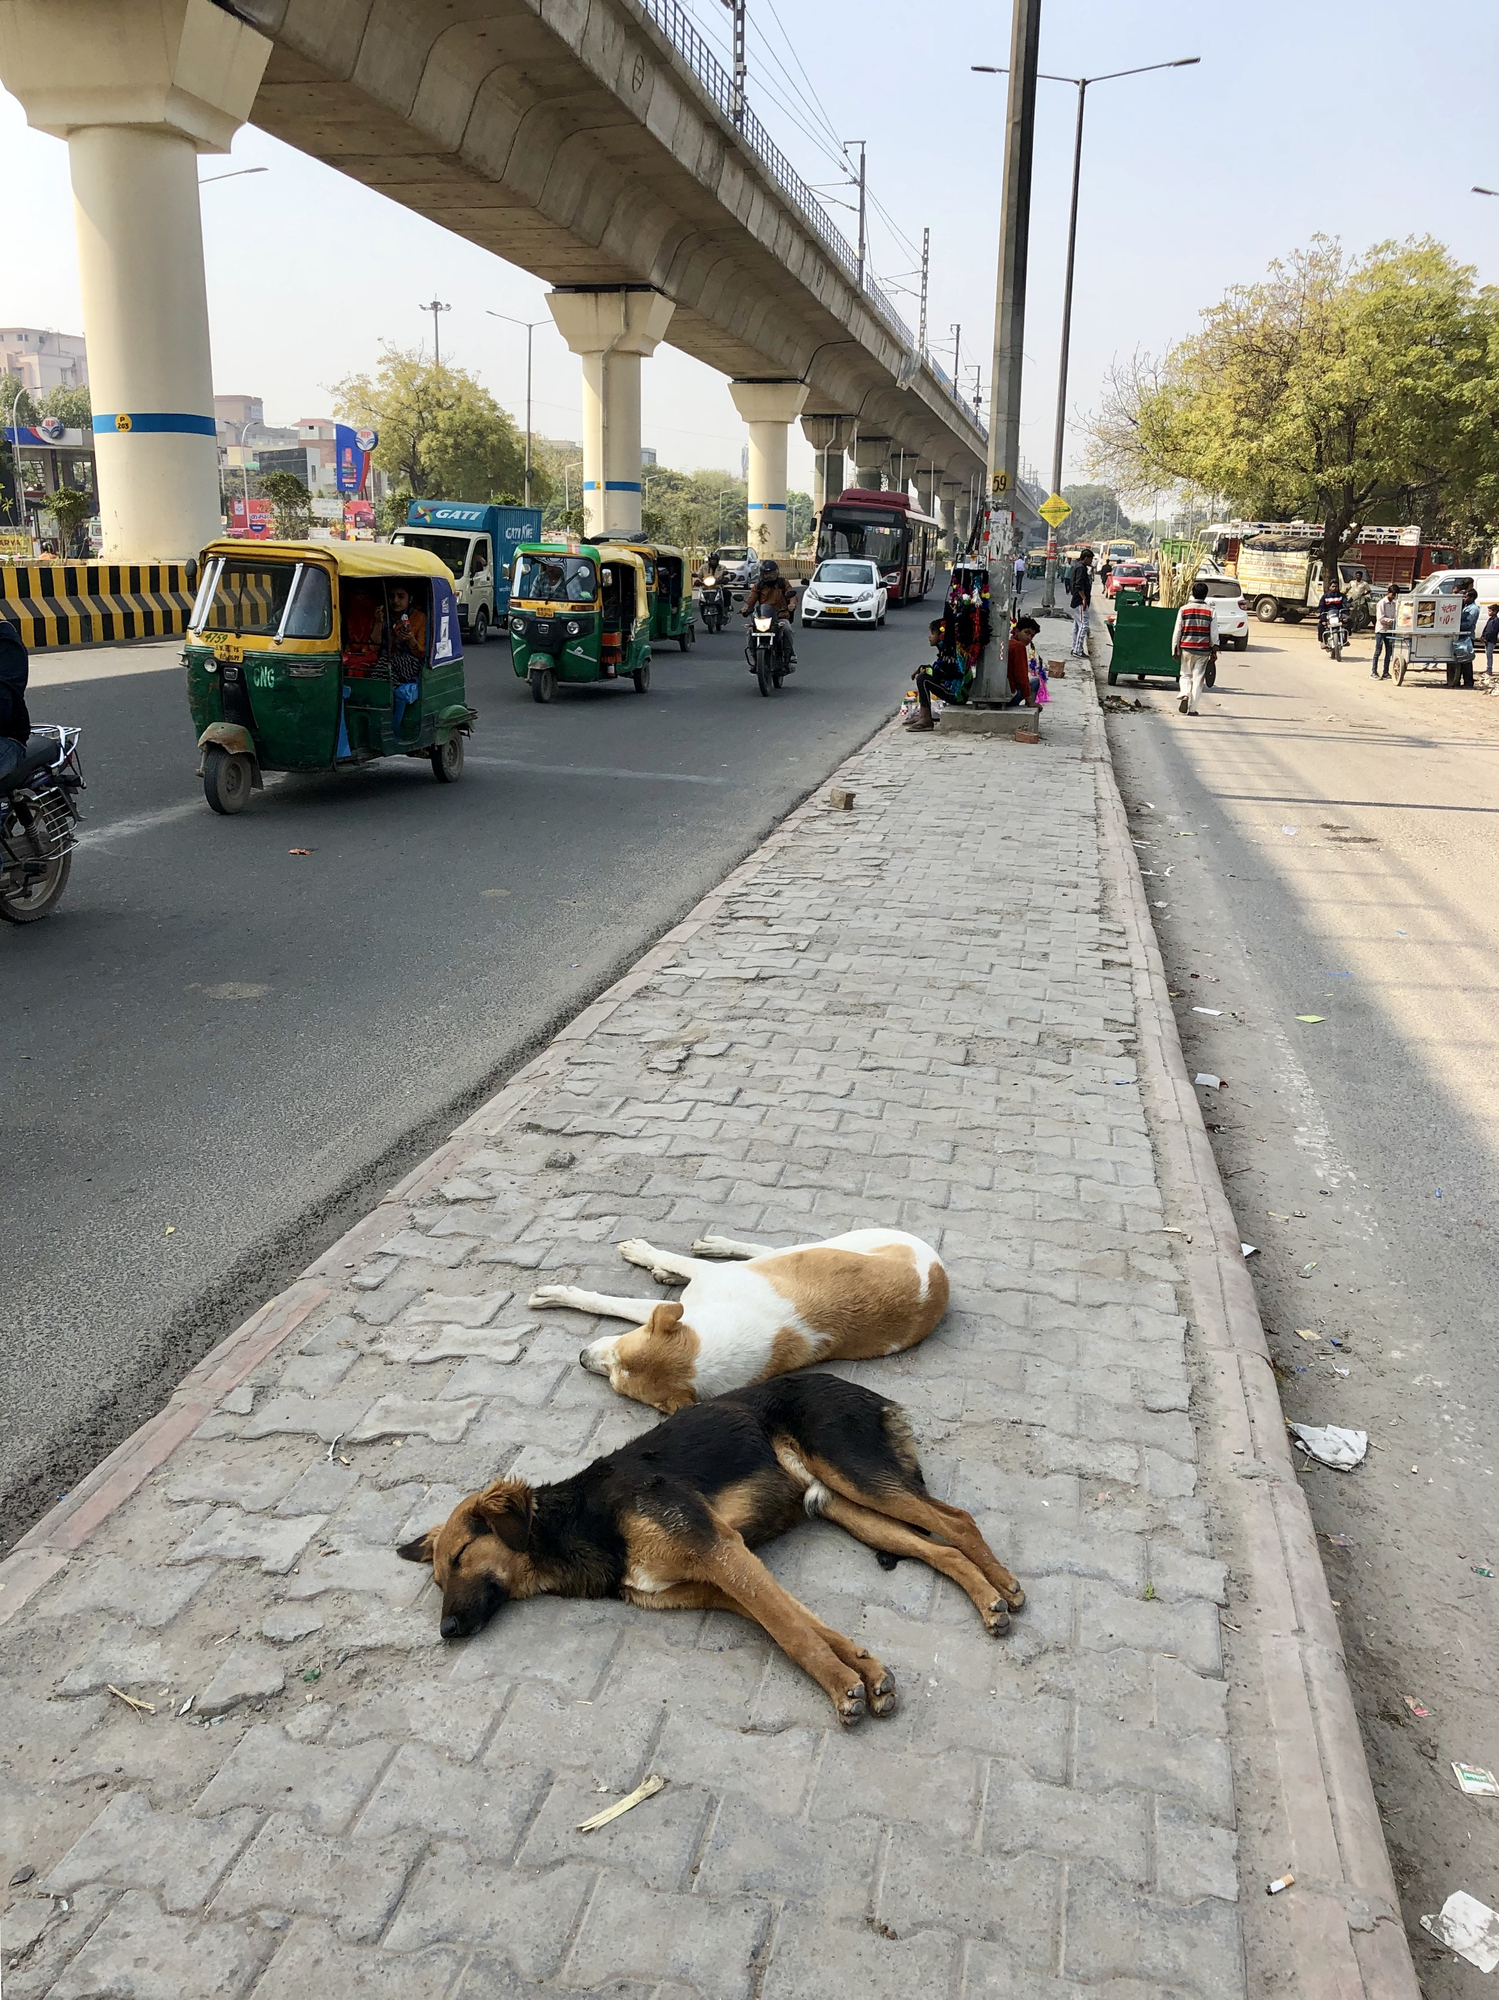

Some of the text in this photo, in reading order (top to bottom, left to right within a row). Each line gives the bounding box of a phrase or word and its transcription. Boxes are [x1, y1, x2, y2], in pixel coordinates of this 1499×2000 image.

[992, 475, 1006, 492] 59
[436, 509, 481, 520] GATI
[204, 633, 228, 643] 4759
[253, 666, 275, 688] CNG
